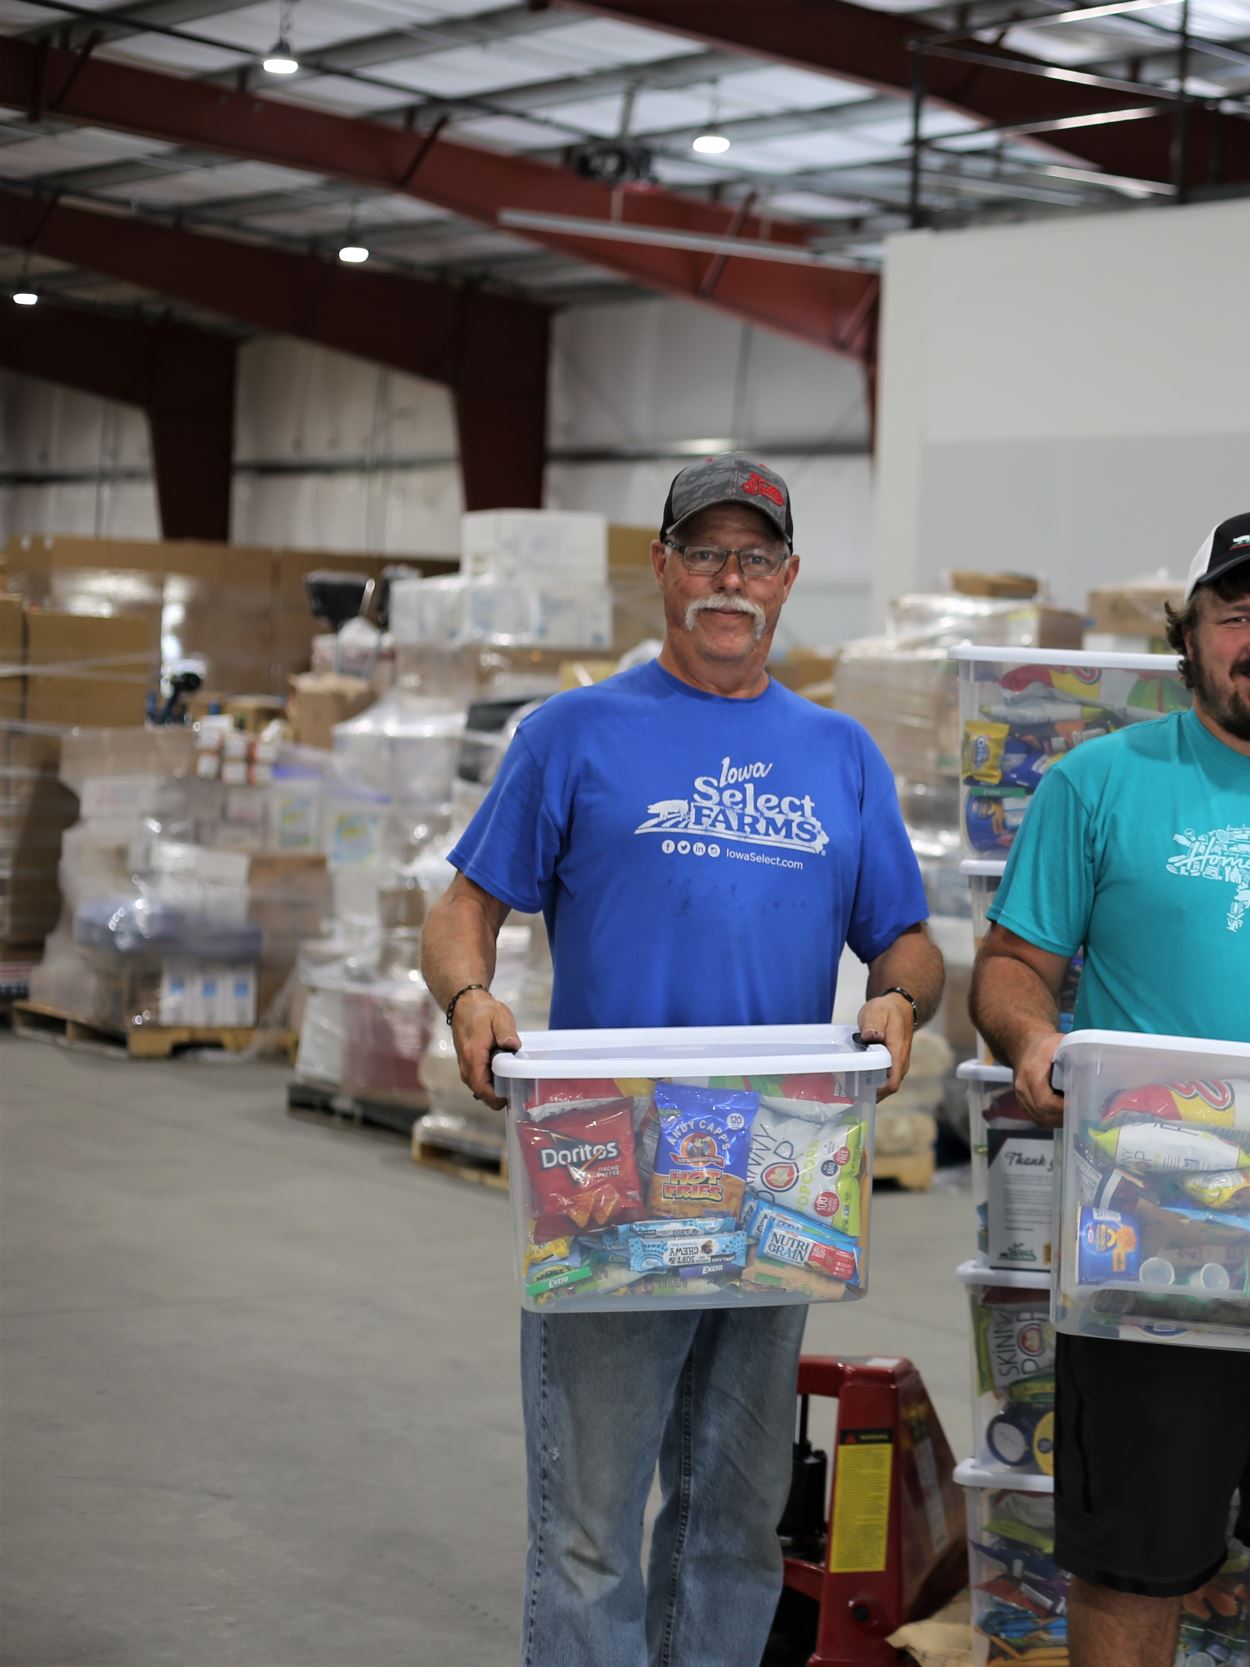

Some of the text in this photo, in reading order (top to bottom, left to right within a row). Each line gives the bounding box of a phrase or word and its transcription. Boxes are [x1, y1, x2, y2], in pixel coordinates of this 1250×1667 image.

[718, 756, 773, 788] Iowa
[692, 776, 816, 822] Select
[692, 803, 818, 844] FARMS
[725, 847, 804, 871] IowaSelect.com
[667, 1119, 695, 1147] ANDY
[698, 1120, 732, 1151] CAPP'S
[541, 1141, 619, 1169] Doritos
[1004, 1151, 1047, 1167] Thank
[670, 1170, 723, 1185] HOT
[664, 1183, 723, 1202] FRIES
[816, 1196, 828, 1212] 100
[669, 1246, 699, 1257] CHEWY
[772, 1232, 810, 1252] NUTRI
[677, 1255, 695, 1264] SOFT
[767, 1243, 807, 1263] GRAIN
[702, 1264, 723, 1275] Extra
[548, 1276, 570, 1289] Extra
[993, 1310, 1021, 1378] SKINNY
